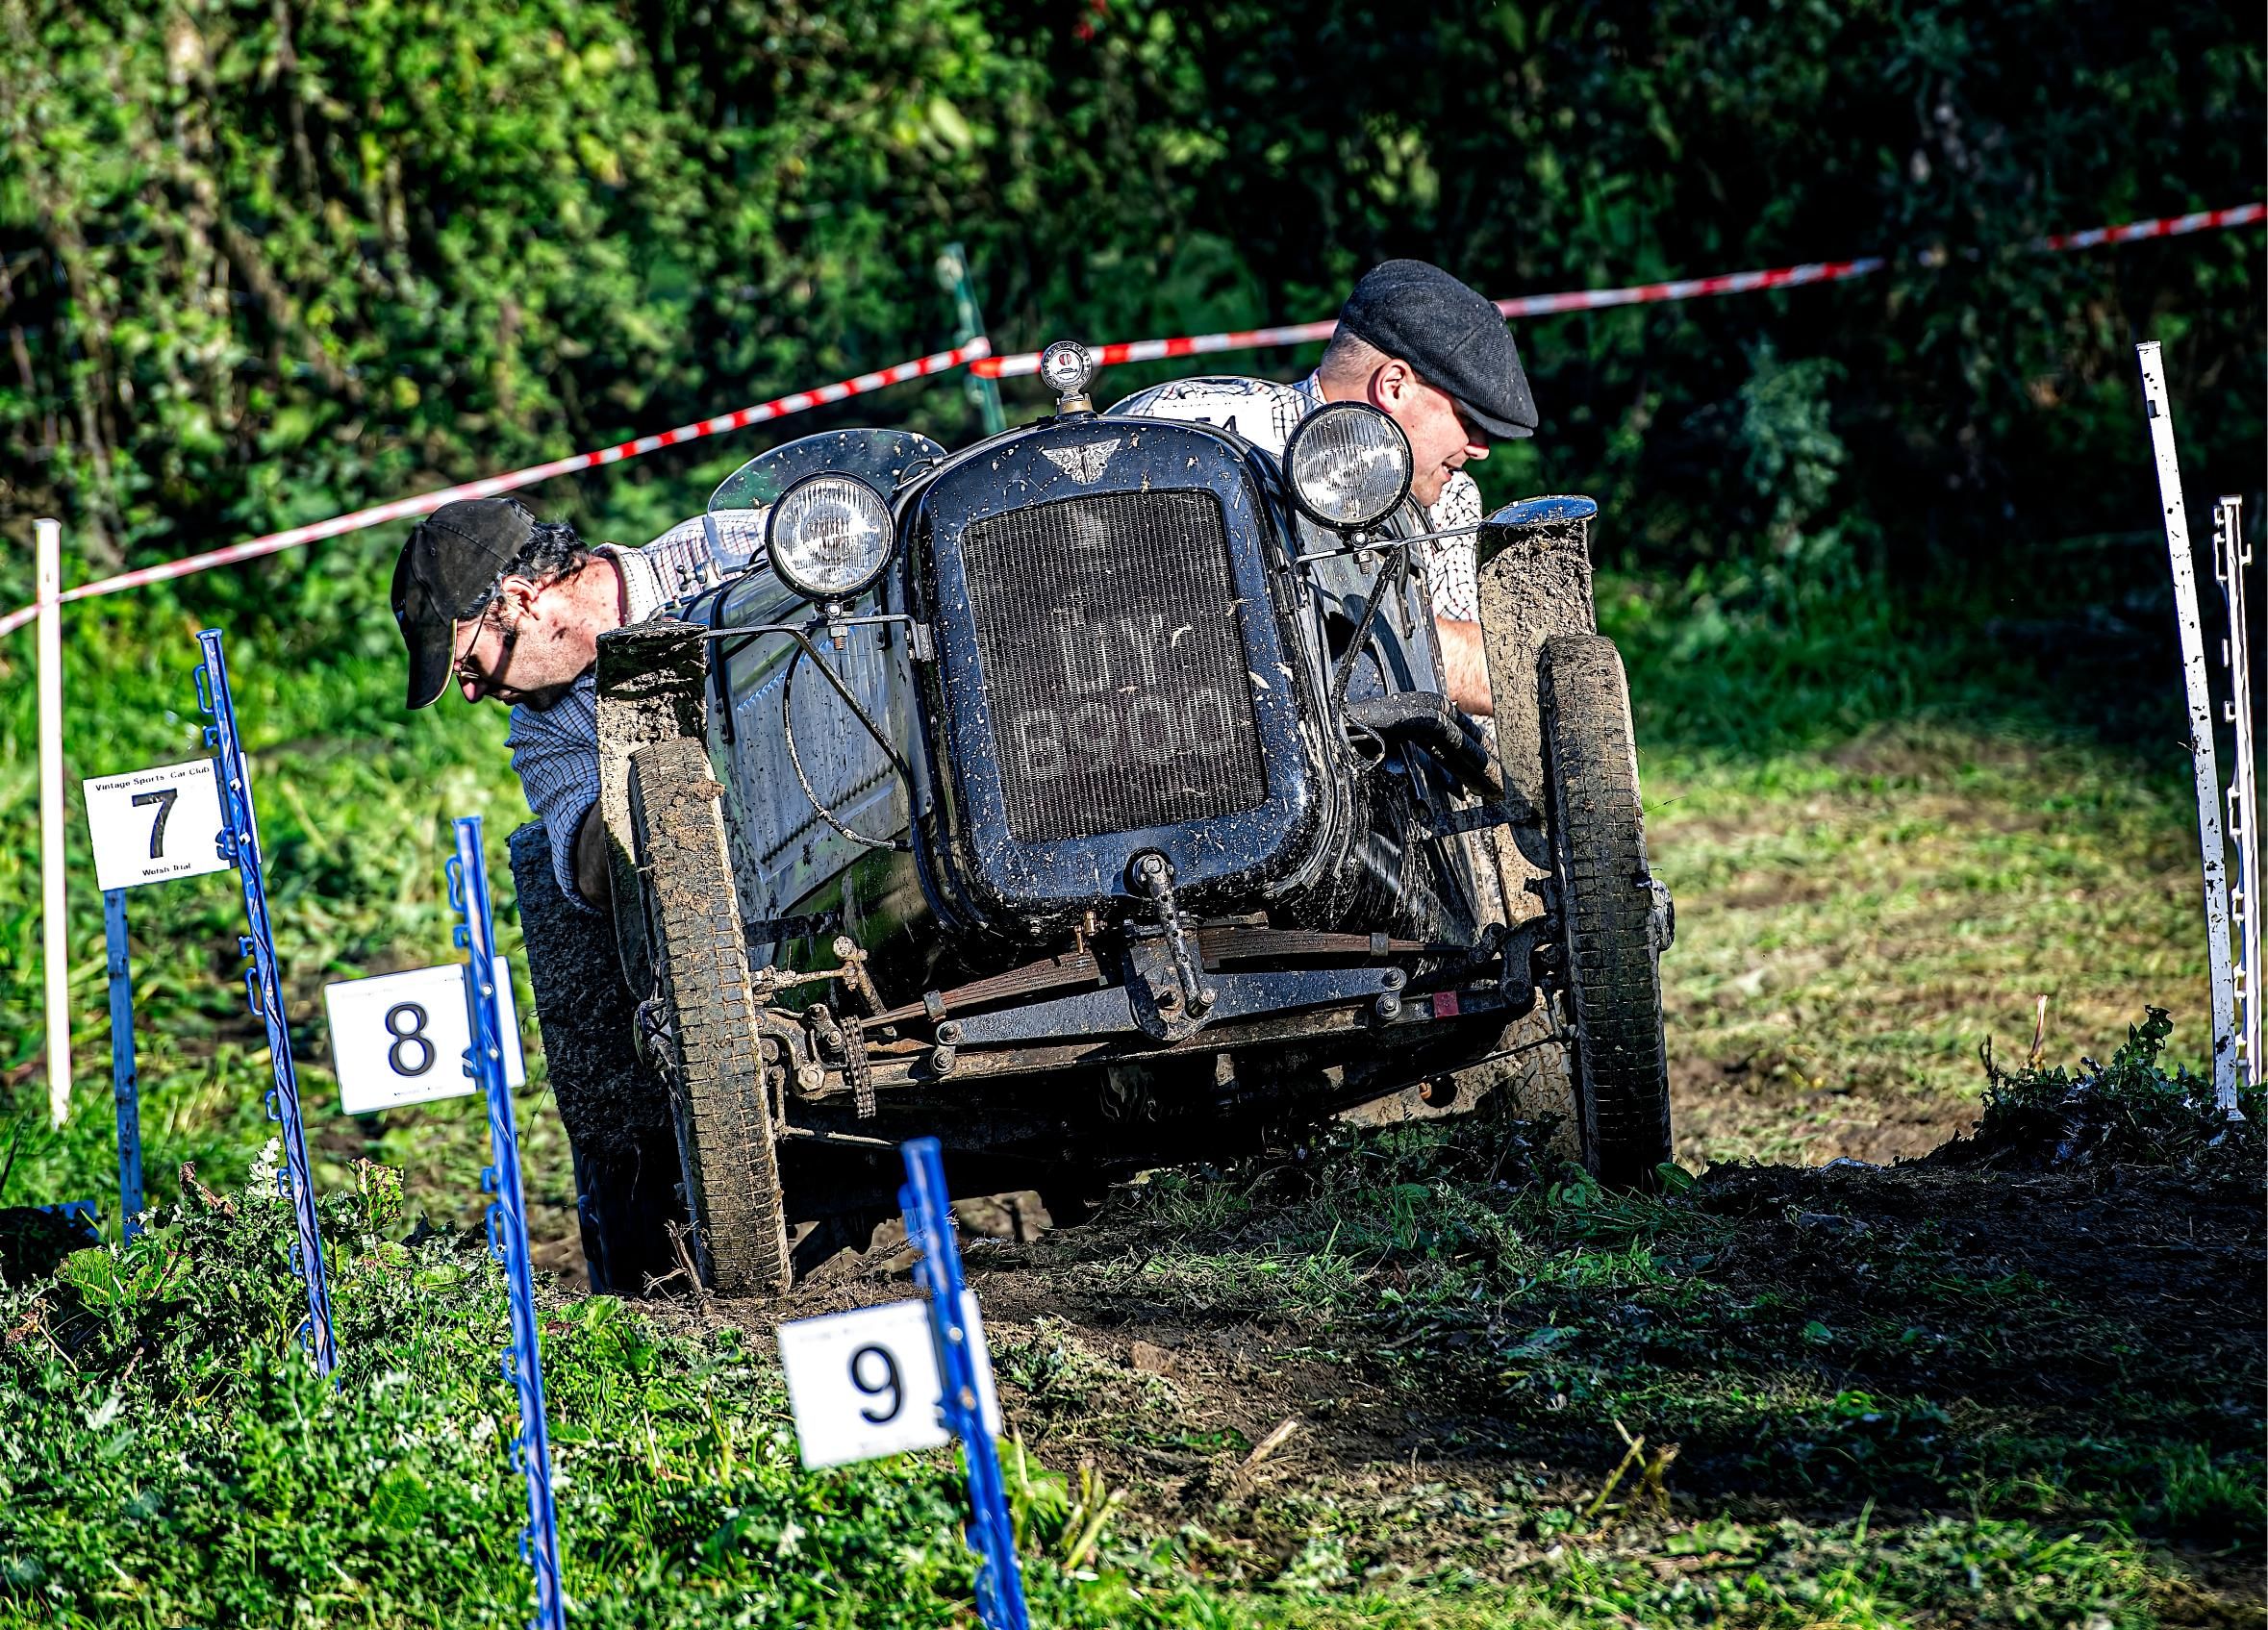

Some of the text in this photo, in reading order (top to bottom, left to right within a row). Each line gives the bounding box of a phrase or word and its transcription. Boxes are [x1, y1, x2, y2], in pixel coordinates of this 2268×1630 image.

[95, 765, 210, 791] Vintage Sports Car Club
[132, 788, 178, 859] 7
[142, 862, 191, 877] Welsh Trial
[385, 1001, 437, 1077] 8
[850, 1344, 903, 1424] 9
